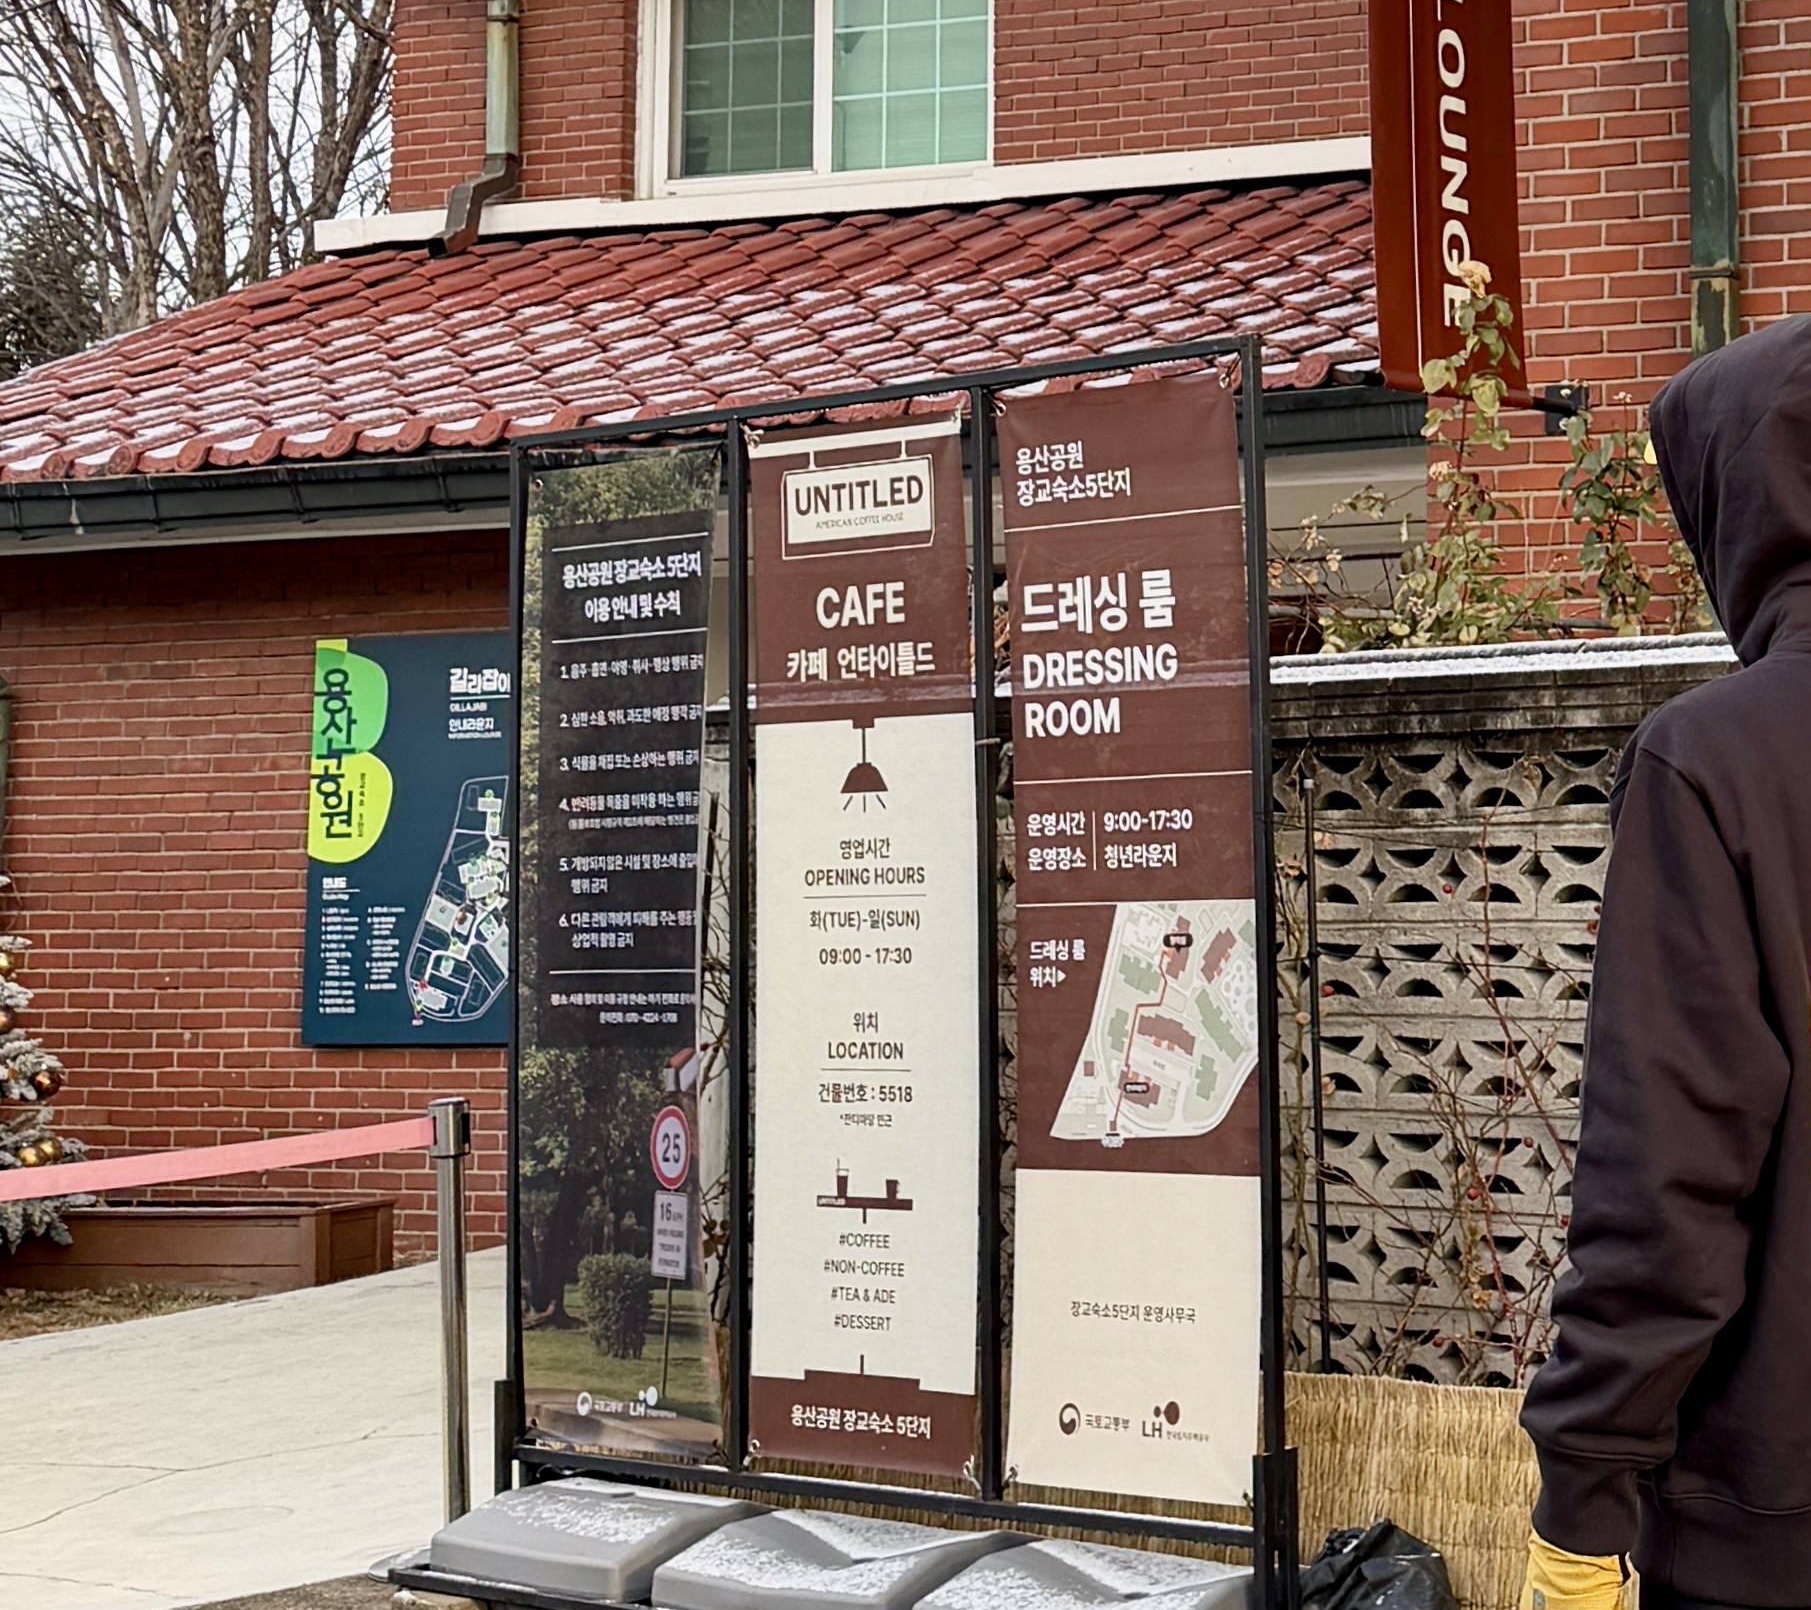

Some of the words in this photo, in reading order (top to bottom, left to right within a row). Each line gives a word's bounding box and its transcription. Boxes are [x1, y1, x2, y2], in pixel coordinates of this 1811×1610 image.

[1015, 440, 1084, 476] 용산공원
[795, 475, 923, 516] UNTITLED
[1016, 467, 1132, 507] 장교숙소5단지
[816, 518, 852, 529] AMERICAN
[562, 561, 613, 589] 용산공원
[613, 555, 666, 584] 장교숙소
[667, 551, 702, 578] 5단지
[585, 597, 610, 623] 이용
[611, 594, 638, 620] 안내
[639, 592, 653, 619] 및
[654, 589, 681, 617] 수칙
[816, 581, 905, 629] CAFE
[1020, 571, 1128, 634] 드레싱
[1139, 568, 1176, 629] 룸
[786, 647, 828, 683] 카페
[837, 642, 936, 679] 언타이틀드
[1022, 643, 1178, 690] DRESSING
[1024, 697, 1121, 739] ROOM
[1026, 811, 1086, 837] 운영시간
[1103, 808, 1193, 832] 9:00-17:30
[839, 837, 891, 860] 영업시간
[1027, 846, 1087, 871] 운영장소
[1104, 842, 1178, 869] 청년라운지
[804, 867, 870, 886] OPENING
[874, 866, 925, 885] HOURS
[819, 948, 862, 964] 09:00
[875, 947, 912, 964] 17:30
[1029, 939, 1070, 962] 드레싱
[1072, 939, 1086, 960] 룸
[1029, 965, 1057, 988] 위치
[853, 1011, 879, 1033] 위치
[828, 1042, 903, 1060] LOCATION
[879, 1086, 913, 1103] 5518
[661, 1132, 682, 1164] 25
[660, 1202, 672, 1222] 16
[839, 1233, 890, 1250] #COFFEE
[824, 1259, 905, 1278] #NON-COFFEE
[831, 1286, 861, 1303] #TEA
[863, 1288, 870, 1303] &
[873, 1288, 896, 1304] ADE
[834, 1314, 892, 1332] #DESSERT
[1071, 1300, 1140, 1322] 장교숙소5단지
[1143, 1305, 1196, 1325] 운영사무국
[629, 1401, 645, 1417] LH
[791, 1404, 842, 1430] 용산공원
[843, 1410, 894, 1435] 장교숙소
[896, 1415, 931, 1440] 5단지
[1084, 1413, 1131, 1432] 국토교통부
[1142, 1420, 1163, 1439] LH
